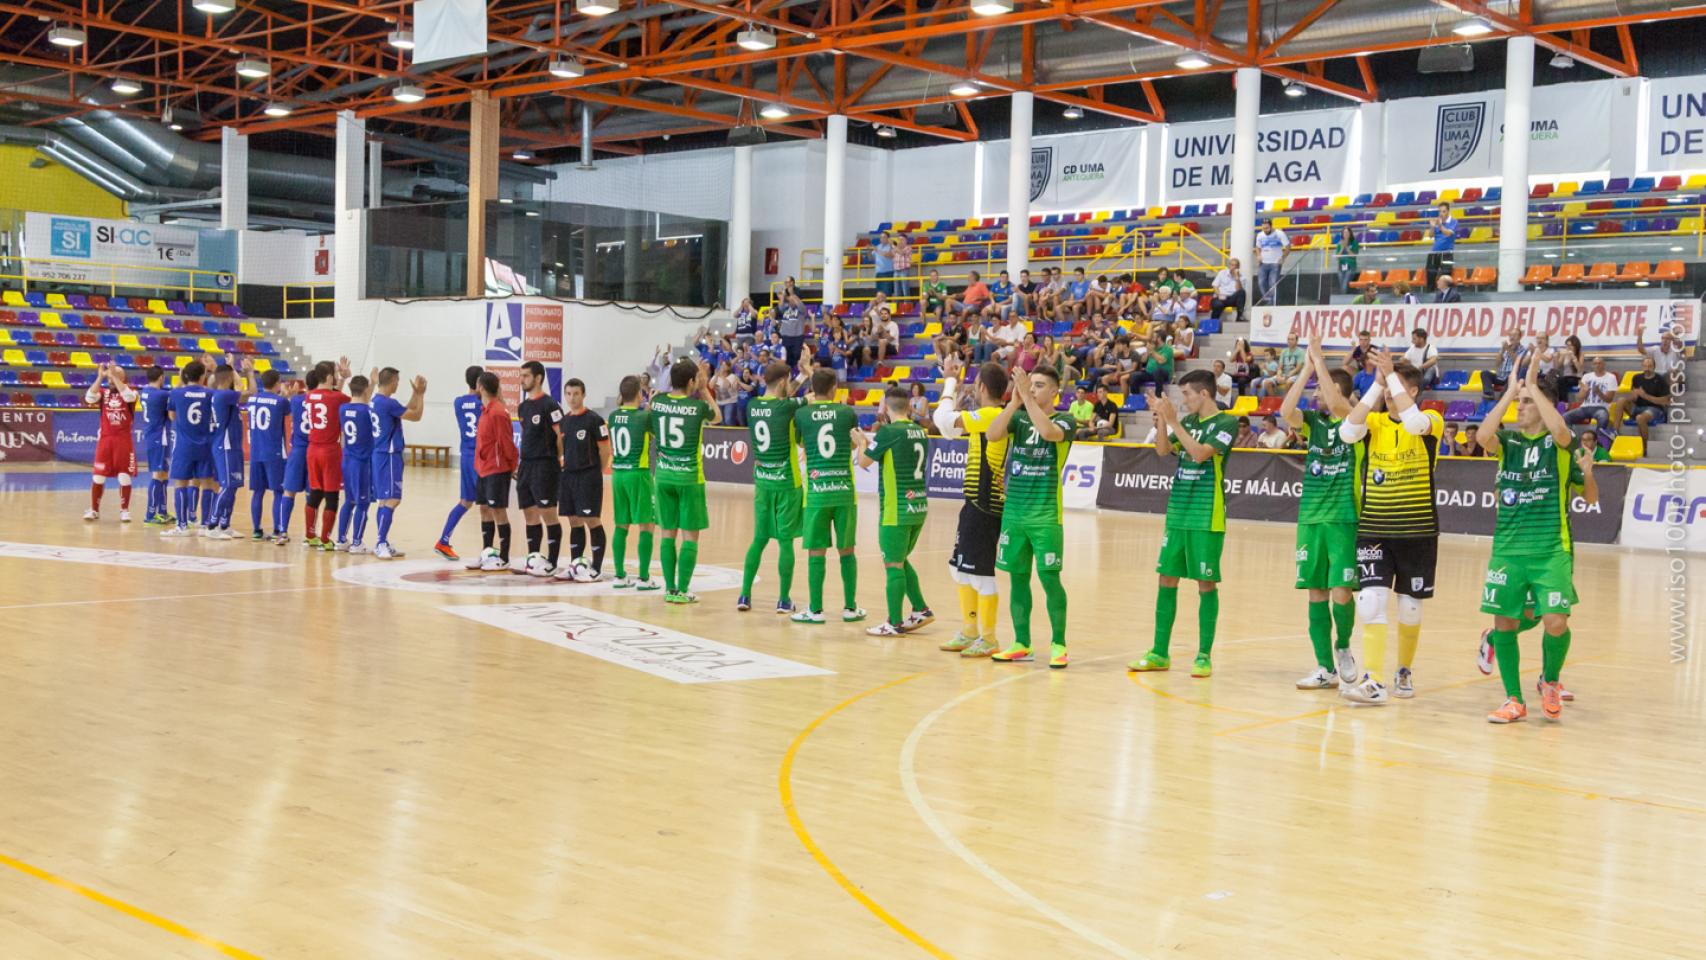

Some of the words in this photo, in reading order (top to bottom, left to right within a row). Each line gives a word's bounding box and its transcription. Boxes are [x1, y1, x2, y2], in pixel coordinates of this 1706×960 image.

[1446, 110, 1476, 122] CLUB
[1174, 127, 1346, 158] UNIVRSIDAD
[1444, 130, 1470, 141] UMA
[1660, 129, 1704, 156] DE
[1063, 165, 1077, 175] CD
[1080, 163, 1105, 173] UMA
[1172, 166, 1202, 188] DE
[1211, 160, 1322, 186] MAGA
[62, 231, 81, 250] SI
[157, 247, 175, 261] 1€
[525, 322, 561, 330] DEPORTIVO
[1289, 308, 1405, 338] ANTEQUERA
[1414, 307, 1494, 338] CIUDAD
[1500, 307, 1538, 337] DEL
[1545, 304, 1649, 337] DEPORTE
[525, 336, 560, 345] MUNICIPAL
[187, 401, 202, 425] 6
[248, 404, 271, 431] 10
[304, 402, 328, 430] 13
[751, 408, 771, 417] DAVID
[811, 410, 836, 421] CRISPI
[56, 429, 101, 443] Autom
[344, 420, 357, 445] 9
[465, 412, 478, 438] 3
[659, 416, 685, 449] 15
[754, 420, 771, 452] 9
[610, 426, 631, 457] 10
[817, 423, 836, 459] 6
[1394, 430, 1399, 448] 1
[913, 442, 925, 480] 2
[1523, 446, 1540, 469] 14
[1245, 476, 1303, 498] MÁLAG
[503, 605, 754, 670] ANTEQUERA
